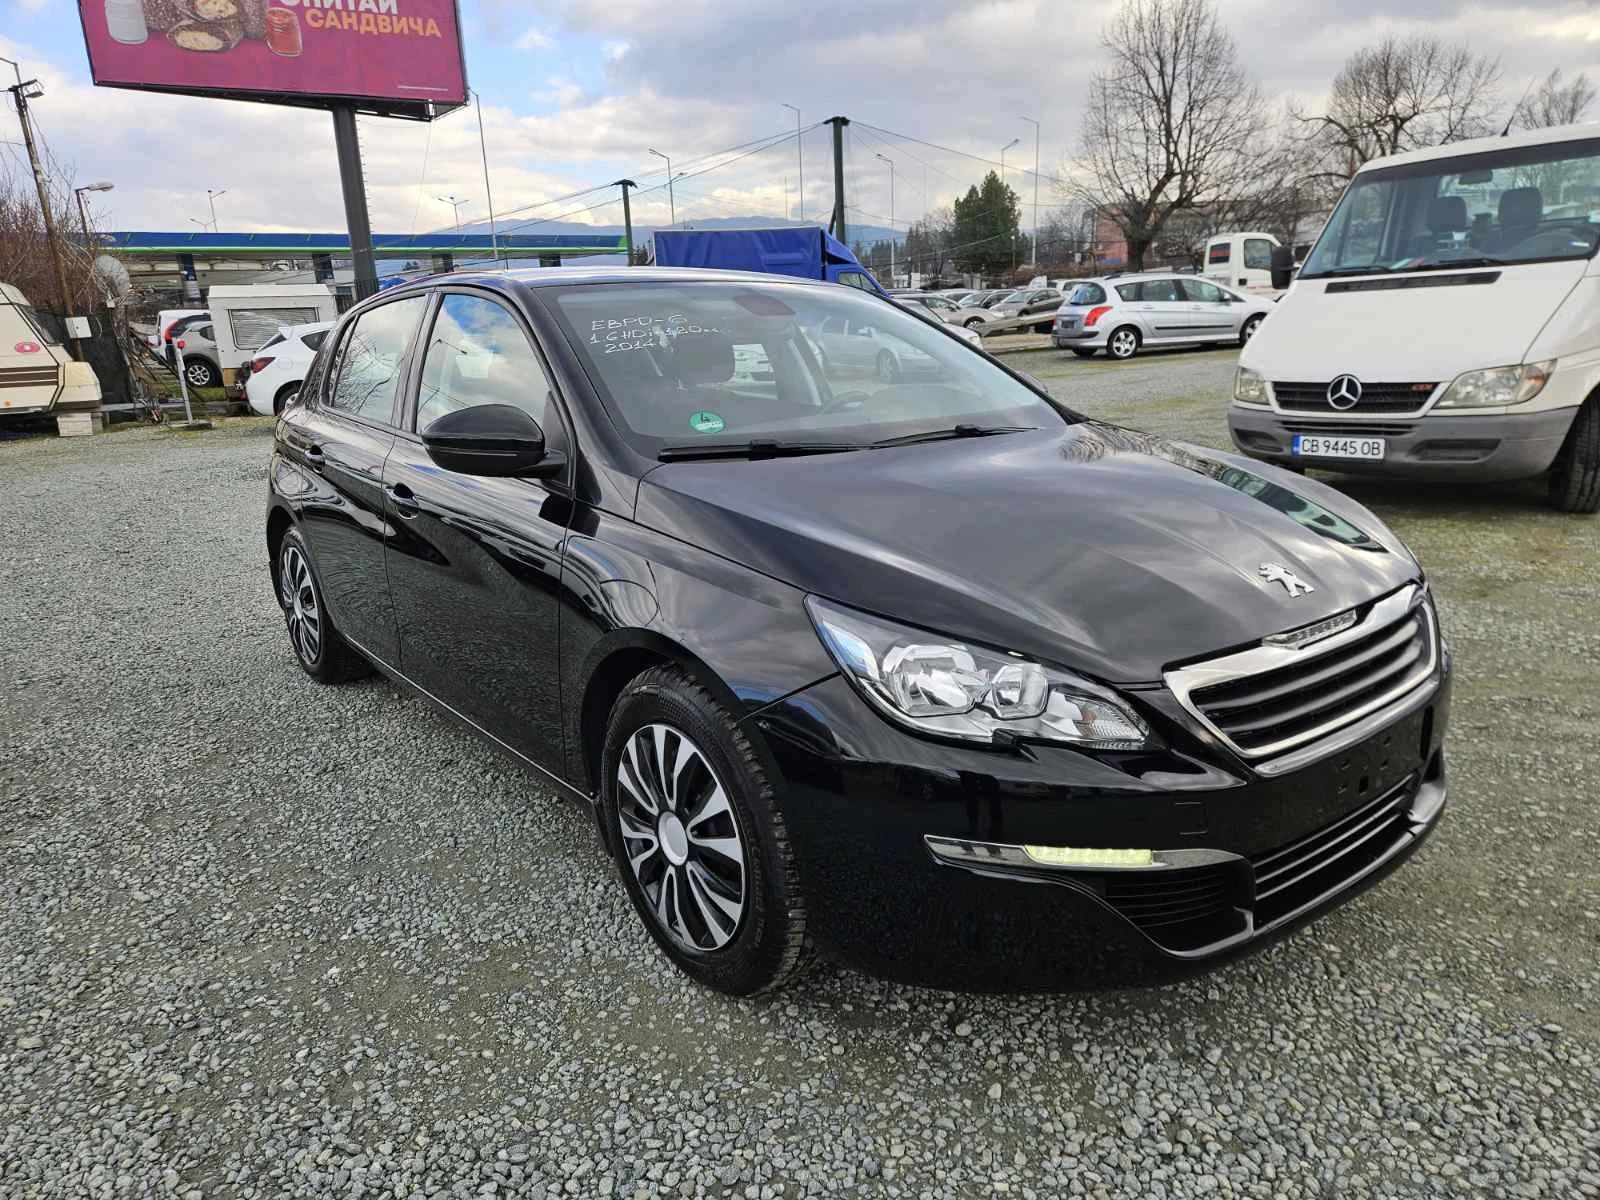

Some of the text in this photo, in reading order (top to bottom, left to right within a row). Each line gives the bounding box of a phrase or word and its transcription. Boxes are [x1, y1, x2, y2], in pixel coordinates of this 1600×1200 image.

[304, 8, 442, 38] САНДВИЧА
[1302, 439, 1319, 453] CB
[1323, 440, 1358, 455] 9445
